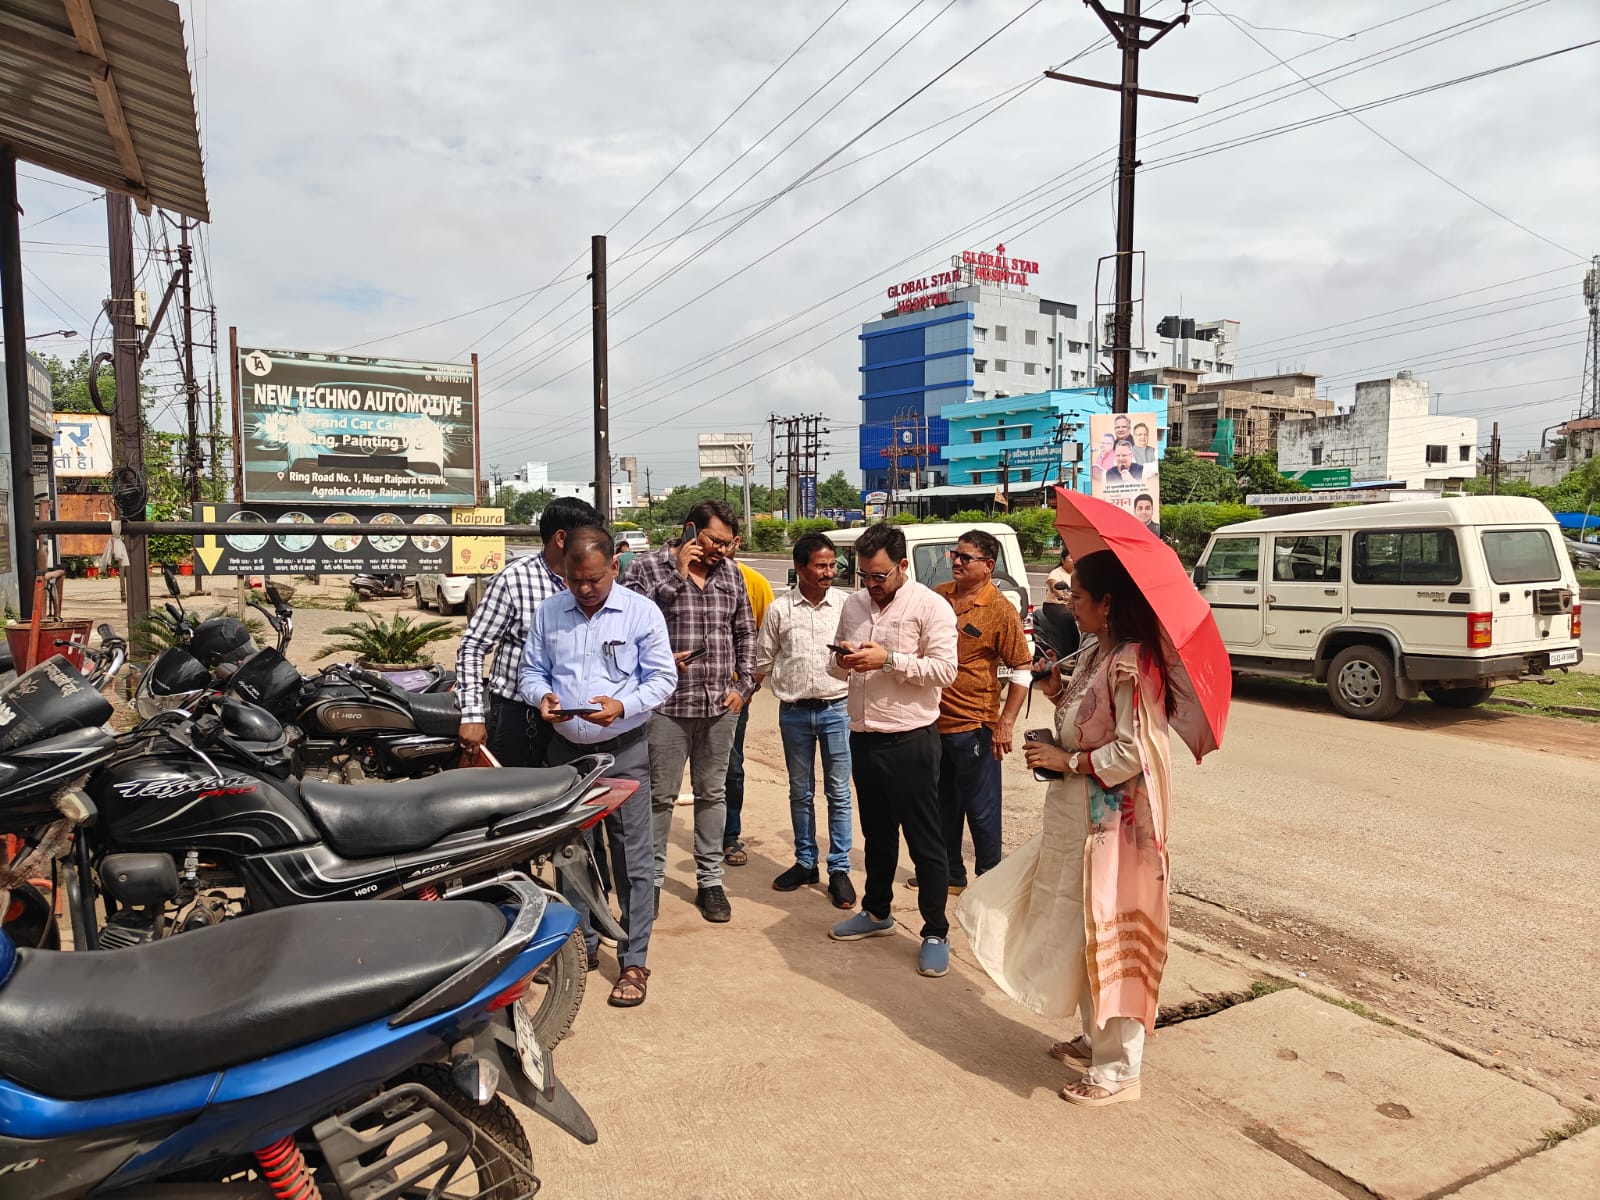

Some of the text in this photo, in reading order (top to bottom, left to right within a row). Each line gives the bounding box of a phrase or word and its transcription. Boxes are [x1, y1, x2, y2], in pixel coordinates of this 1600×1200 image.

[961, 250, 1039, 274] GLOBAL STAR
[887, 269, 961, 298] GLOBAL STAR
[975, 266, 1029, 286] HOSPITAL
[897, 291, 949, 313] HOSPITAL
[254, 383, 463, 416] NEW TECHNO AUTOMOTIVE
[351, 417, 374, 430] Car
[342, 434, 399, 451] Painting
[289, 471, 310, 484] Ring
[312, 472, 335, 482] Road
[336, 473, 352, 482] No.
[362, 473, 384, 484] Near
[385, 474, 417, 486] Raipura
[312, 486, 431, 500] Agroha Colony, Raipur (C.G.)
[455, 512, 503, 526] Raipura
[353, 883, 378, 897] Hero
